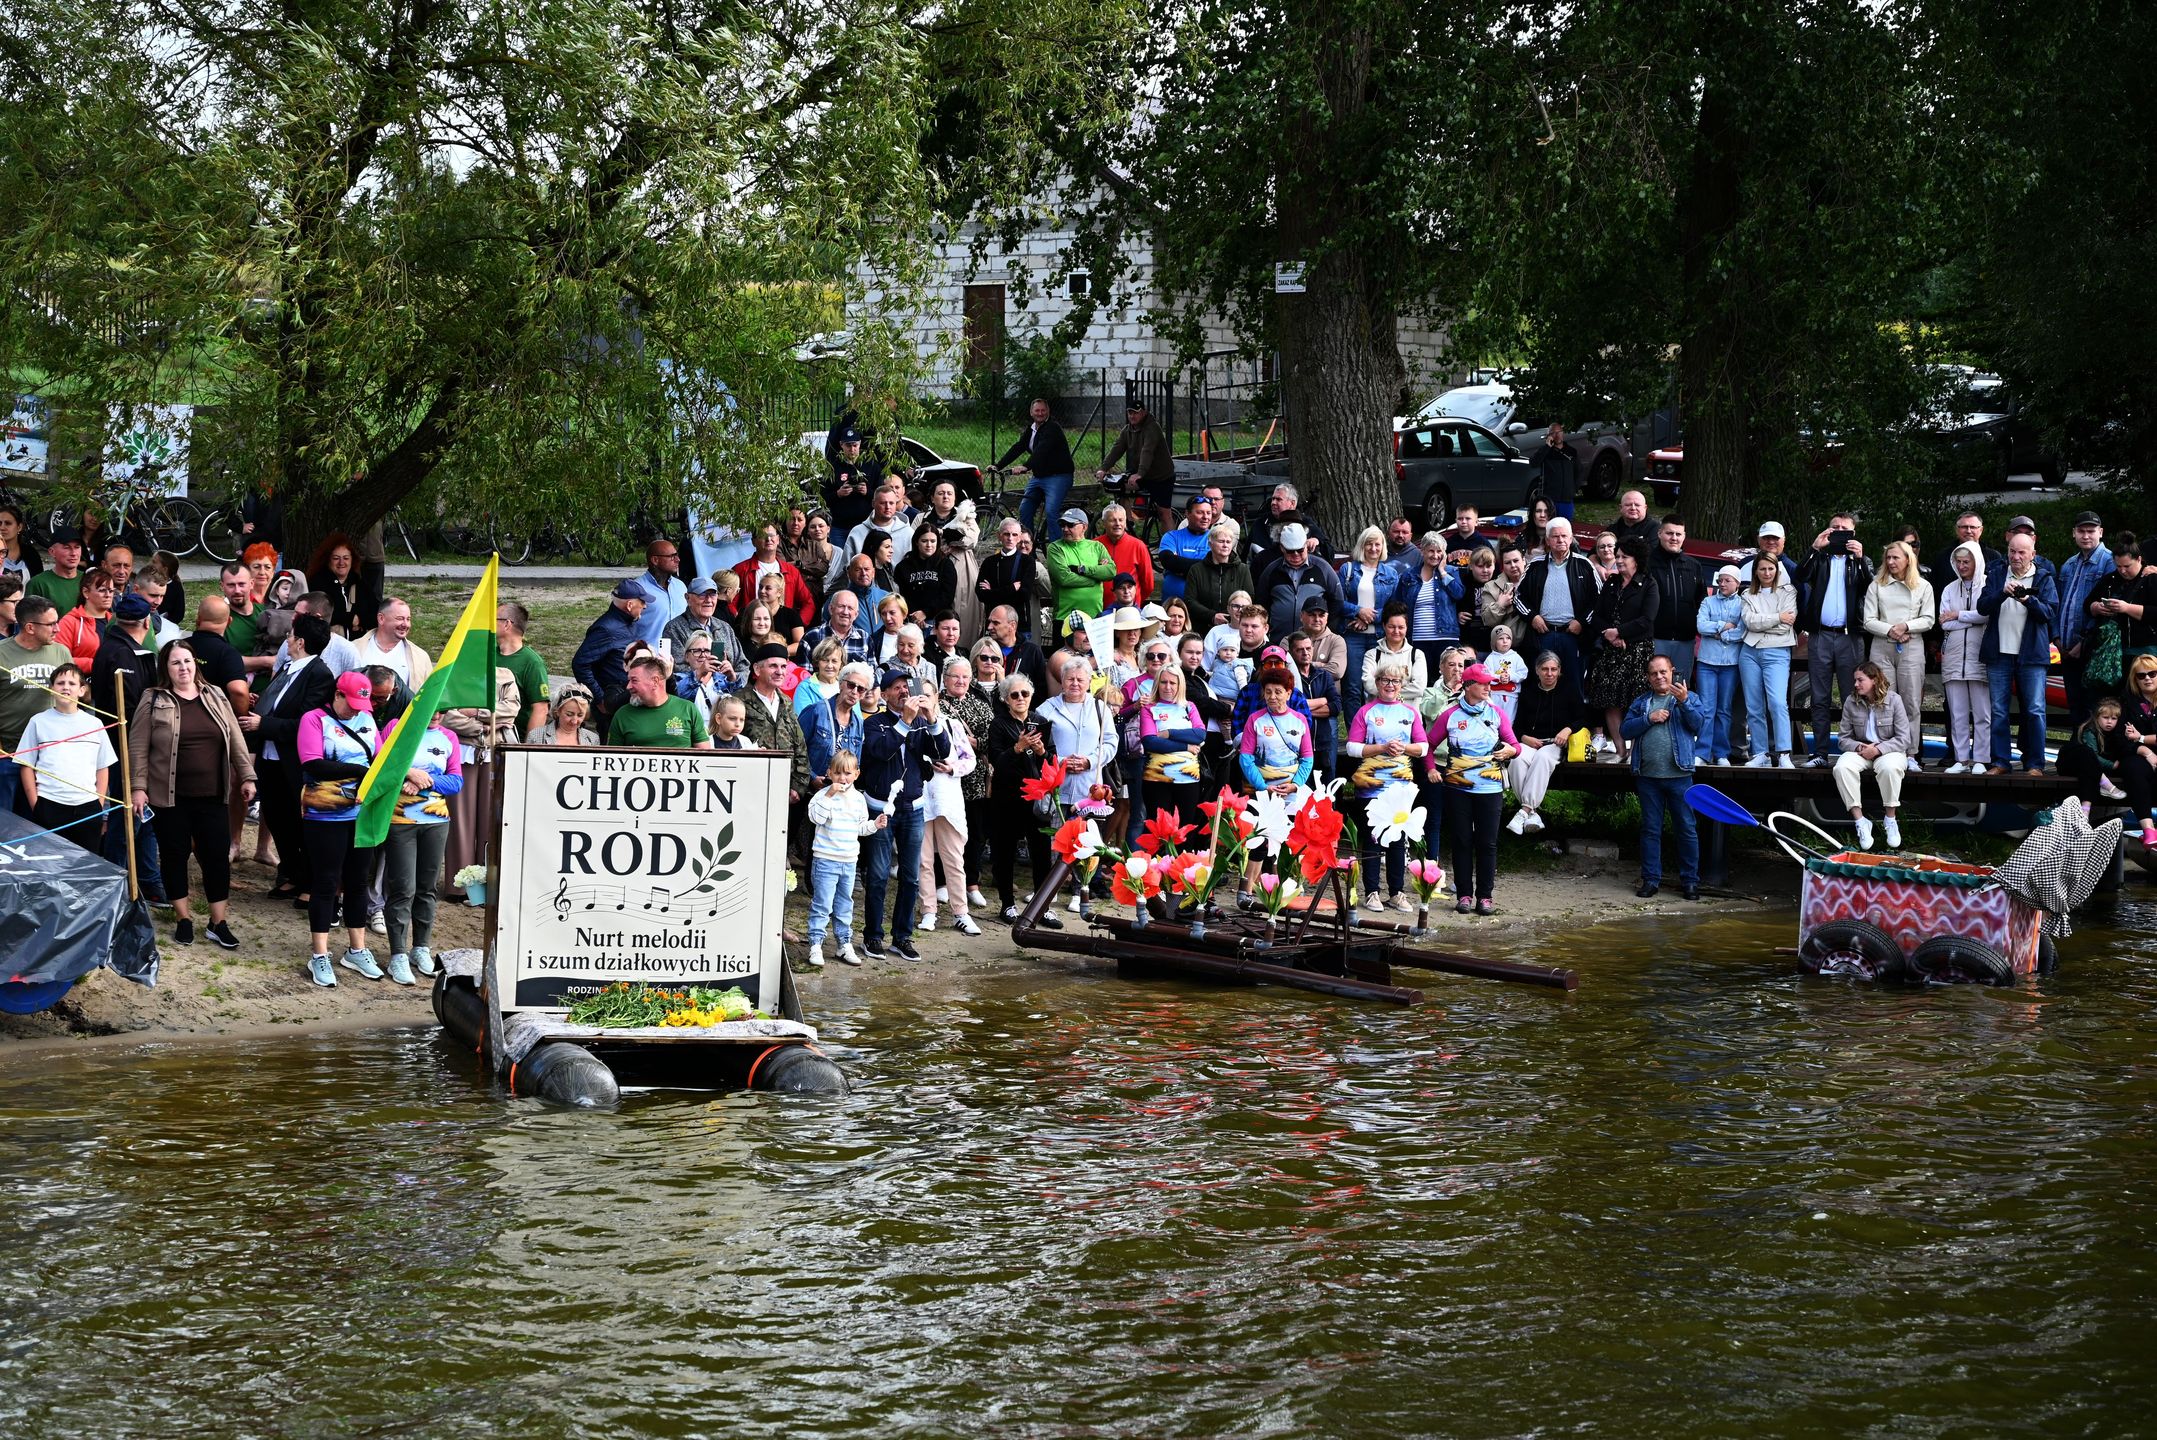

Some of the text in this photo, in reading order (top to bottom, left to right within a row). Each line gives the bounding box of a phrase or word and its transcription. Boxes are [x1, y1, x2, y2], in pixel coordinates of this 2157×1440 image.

[10, 663, 57, 684] BOSTO
[592, 757, 701, 774] FRYDERYK
[556, 774, 737, 814] CHOPIN
[634, 815, 640, 829] i
[557, 830, 687, 876] ROD
[574, 927, 706, 949] Nurt melodii
[527, 950, 751, 977] i szum działkowych liści
[567, 985, 609, 995] RODZIN
